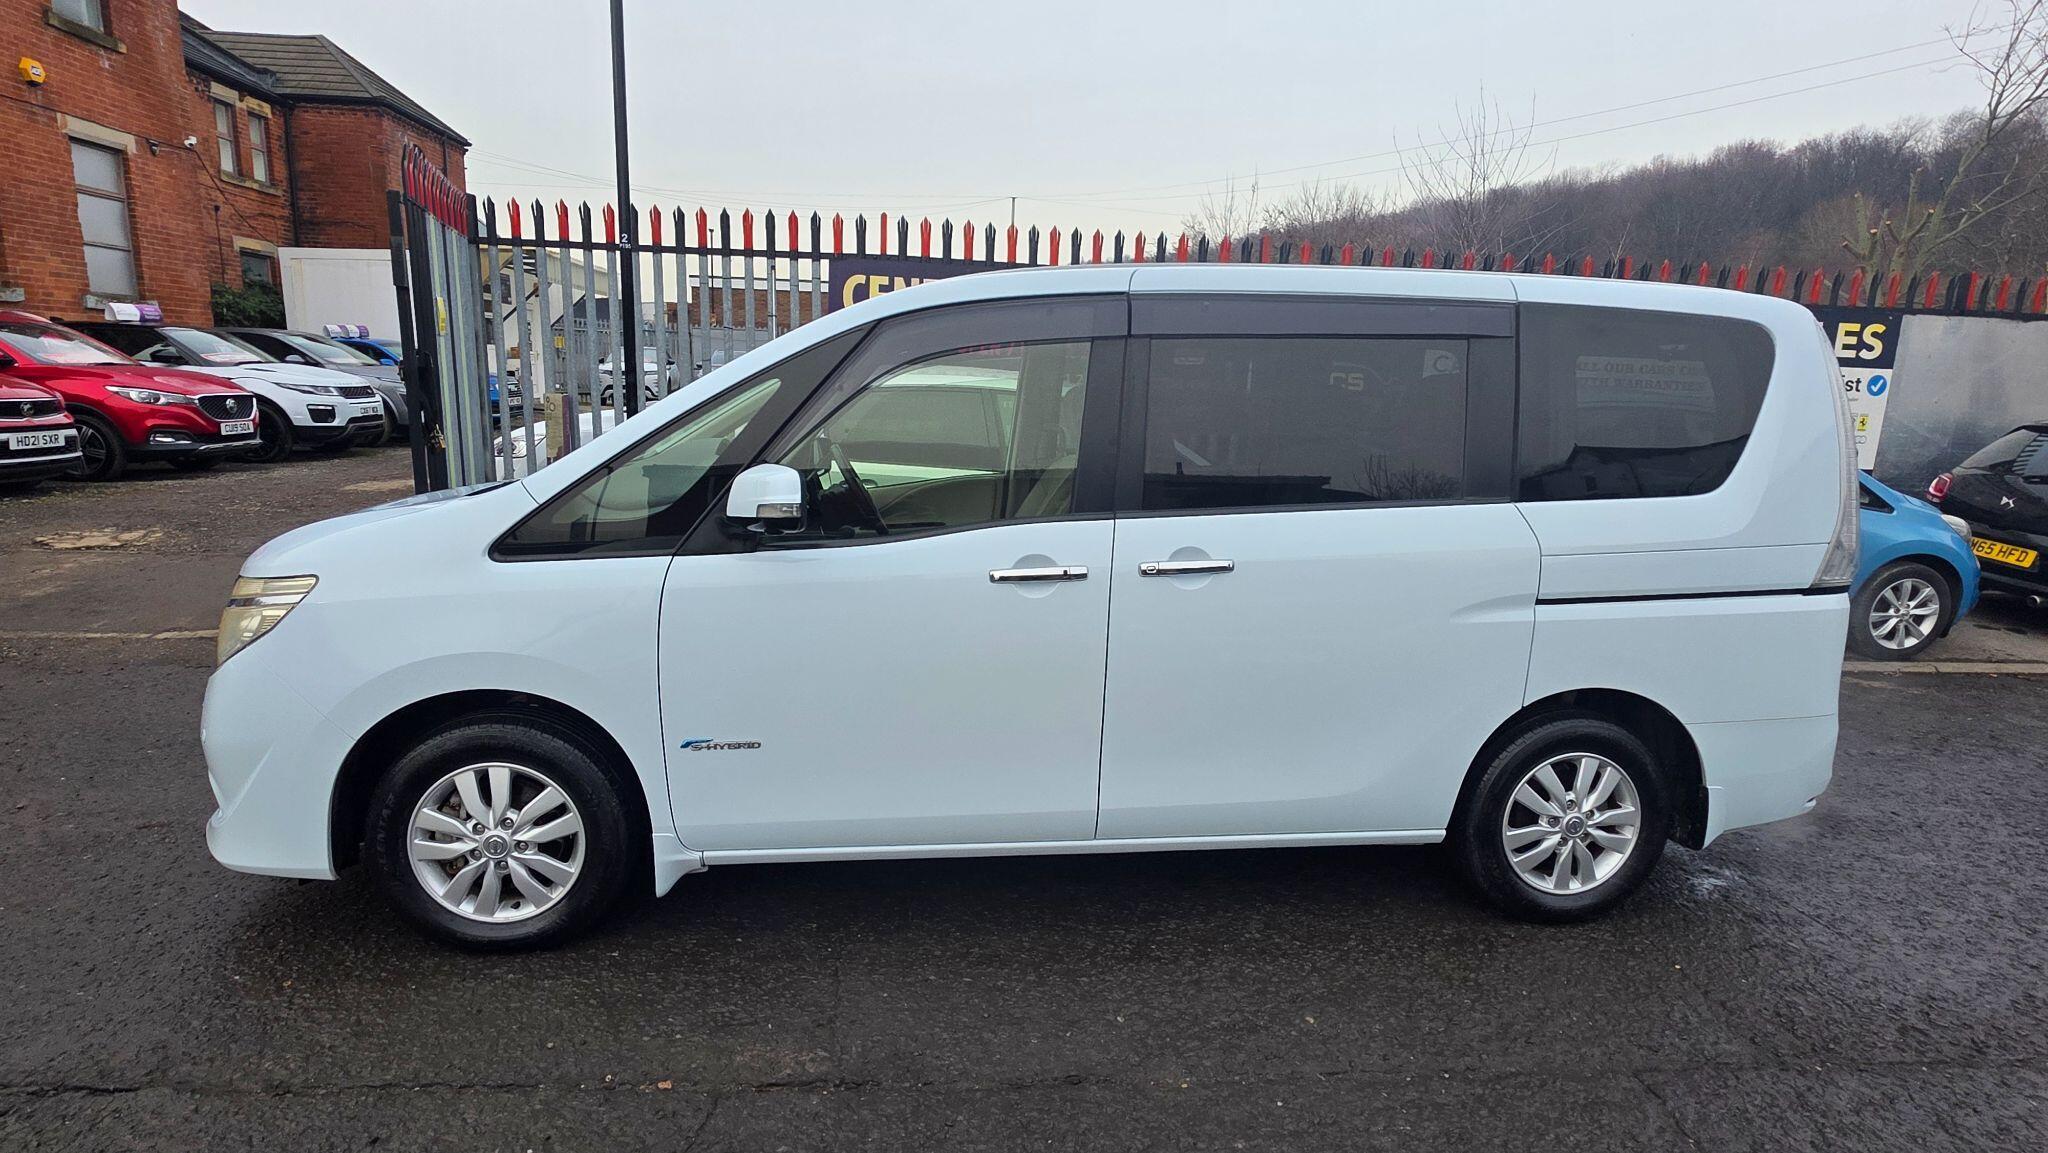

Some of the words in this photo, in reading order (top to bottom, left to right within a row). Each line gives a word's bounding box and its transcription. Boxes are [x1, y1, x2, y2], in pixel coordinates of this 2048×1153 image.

[621, 233, 628, 243] 2
[1820, 321, 1887, 360] ES
[16, 435, 40, 447] HD21
[42, 433, 60, 445] SXR
[1996, 545, 2029, 563] HFD
